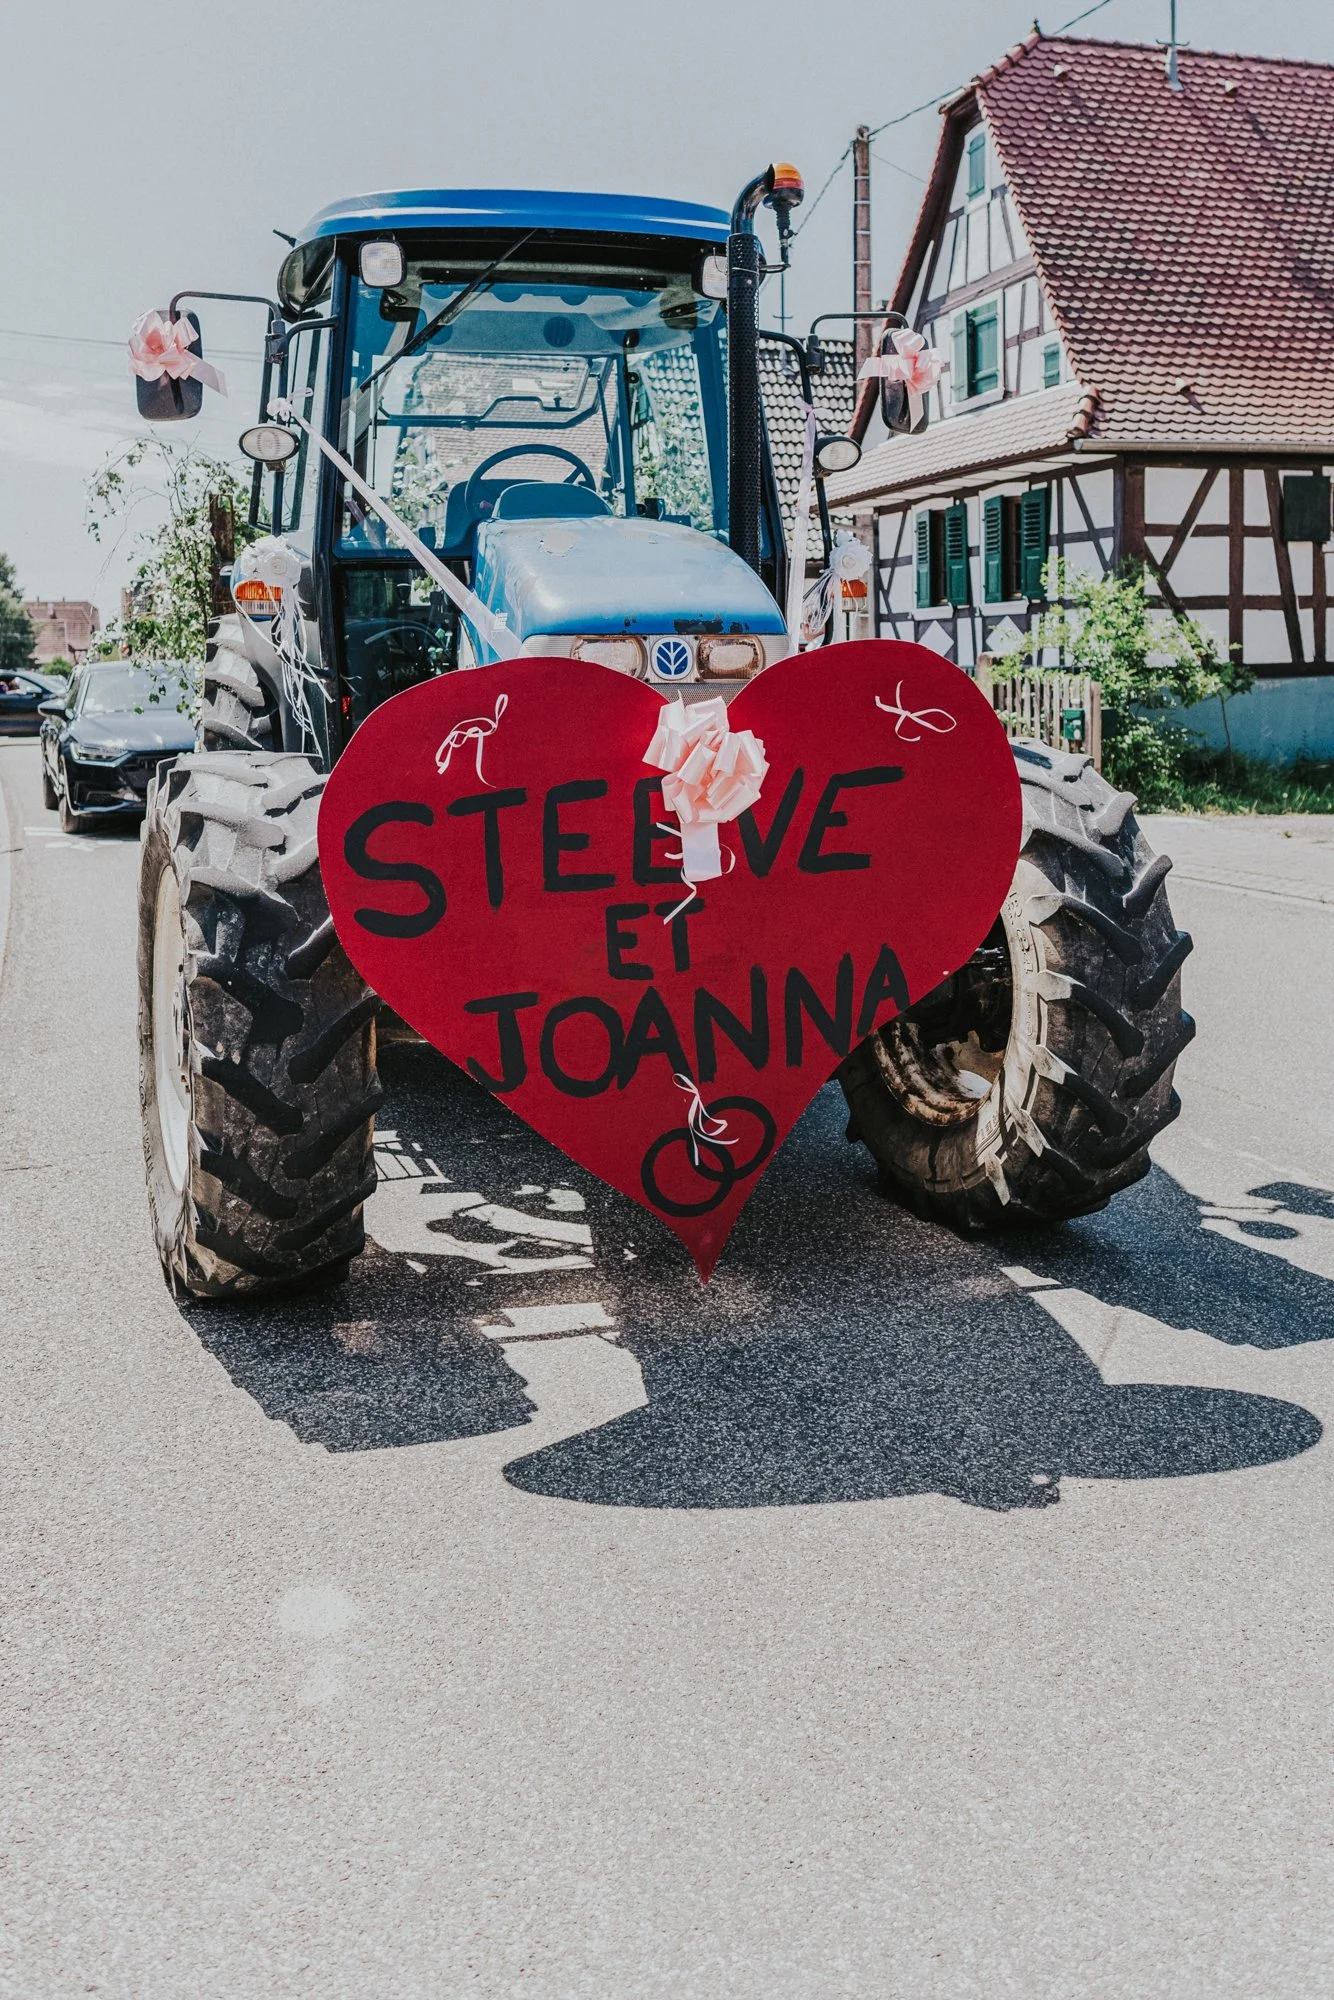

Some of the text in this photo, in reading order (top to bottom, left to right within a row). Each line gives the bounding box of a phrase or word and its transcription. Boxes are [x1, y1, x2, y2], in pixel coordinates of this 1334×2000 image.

[343, 765, 906, 939] STEEVE
[605, 897, 706, 981] ET
[462, 942, 911, 1099] JOANNA
